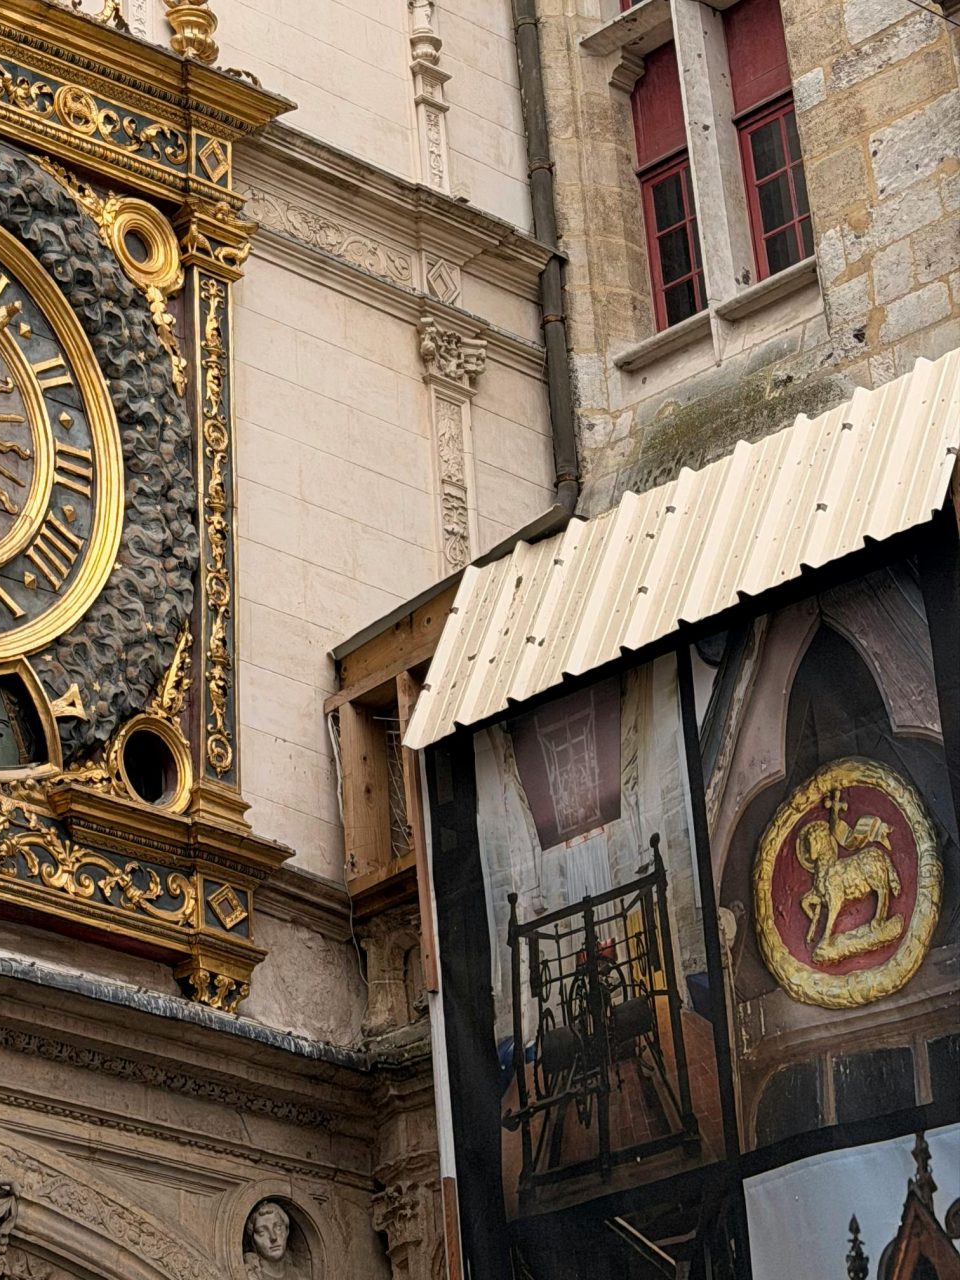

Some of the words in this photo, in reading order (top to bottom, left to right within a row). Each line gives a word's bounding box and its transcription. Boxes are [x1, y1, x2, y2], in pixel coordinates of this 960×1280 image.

[31, 353, 74, 393] II
[53, 437, 92, 499] III
[25, 509, 85, 592] IIII
